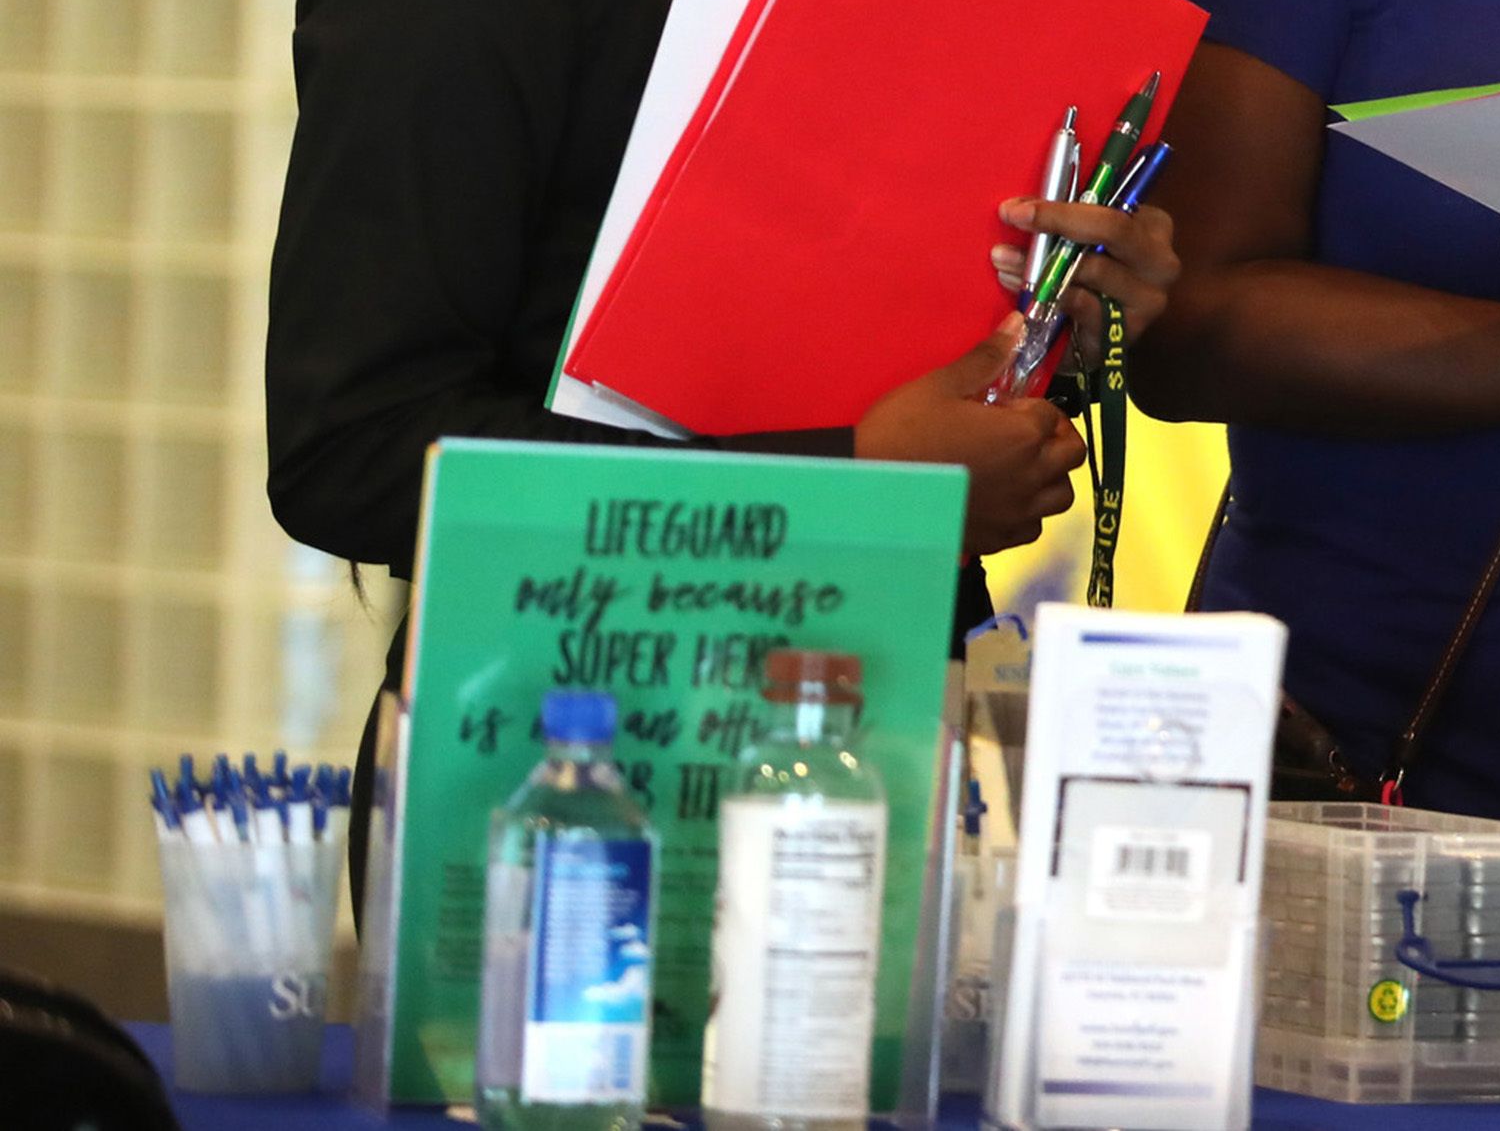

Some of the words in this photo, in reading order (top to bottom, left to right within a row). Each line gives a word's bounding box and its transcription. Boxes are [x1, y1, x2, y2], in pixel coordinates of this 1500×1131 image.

[585, 499, 789, 563] LIFEGUARD
[647, 573, 845, 625] because
[553, 630, 677, 689] SUPER
[690, 633, 790, 689] HER
